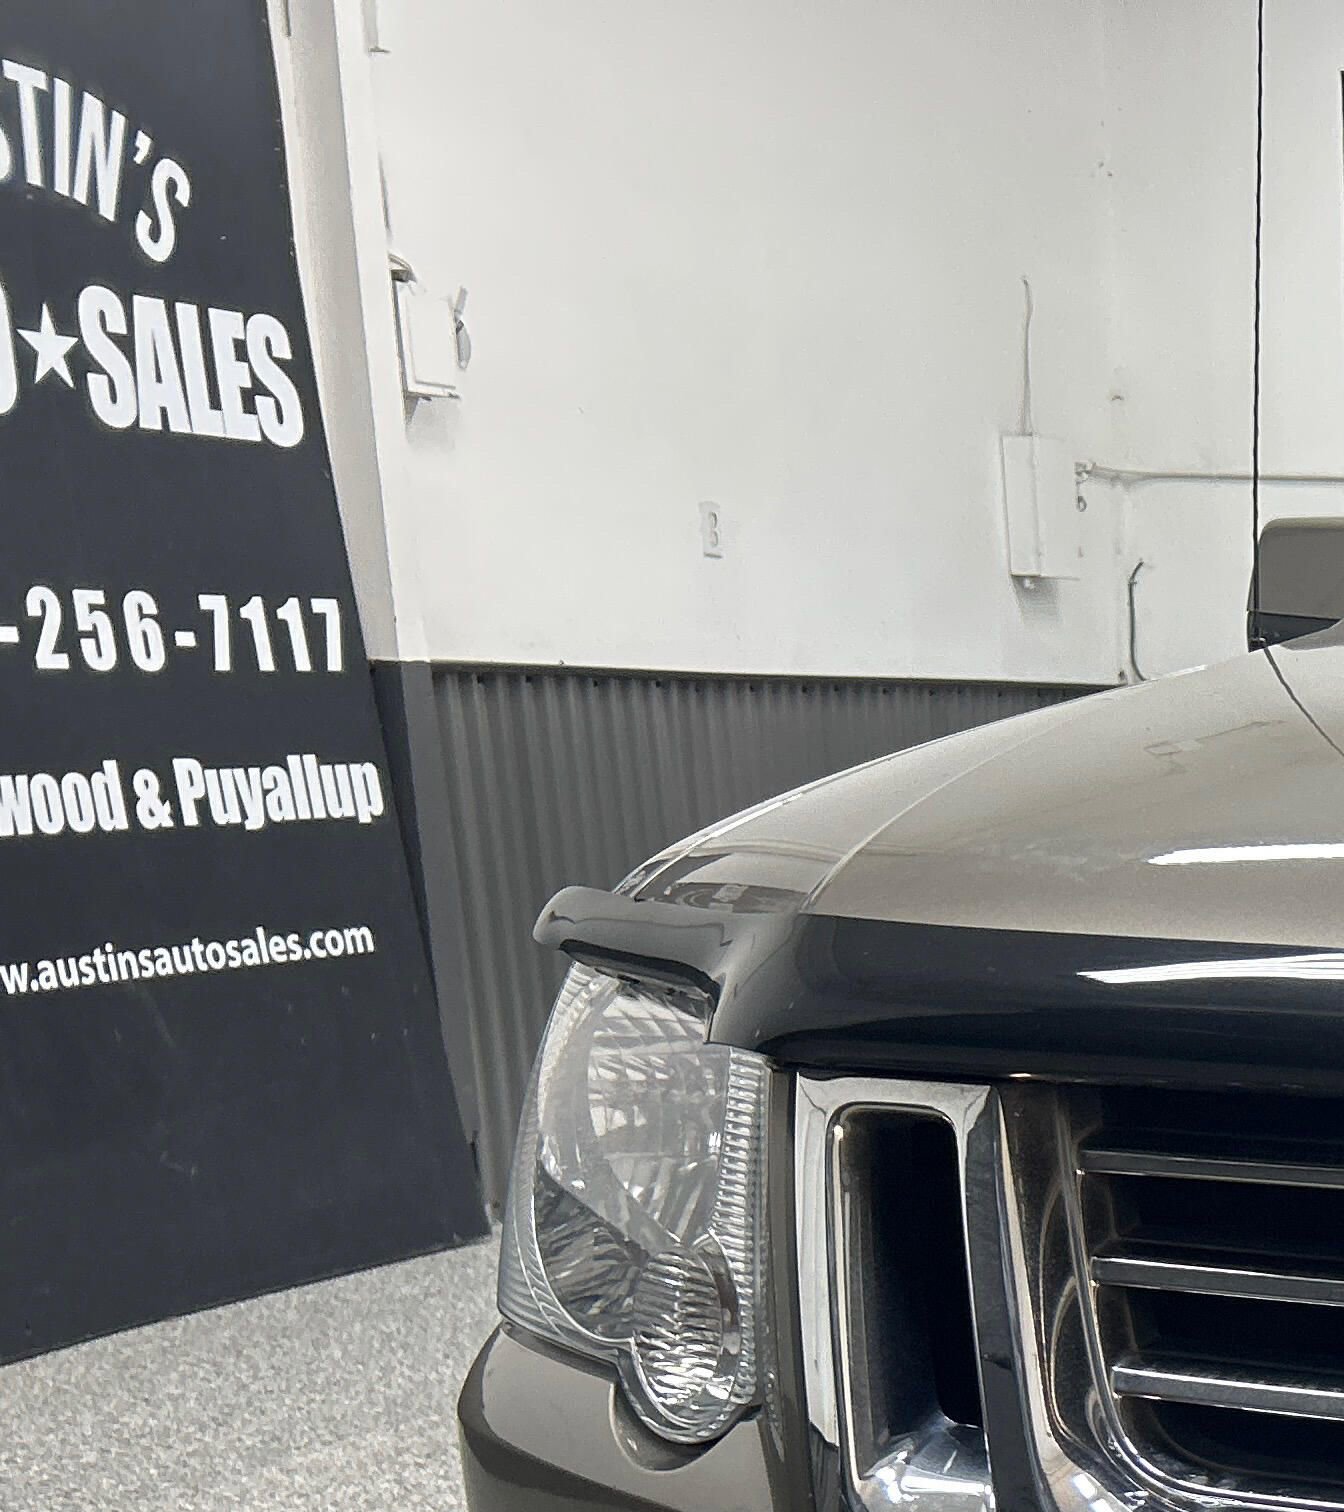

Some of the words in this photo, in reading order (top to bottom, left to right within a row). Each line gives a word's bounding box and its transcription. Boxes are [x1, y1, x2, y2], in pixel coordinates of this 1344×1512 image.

[0, 58, 191, 264] TIN'S
[78, 284, 304, 448] SALES
[133, 768, 174, 830] &
[172, 754, 385, 831] Puyallup
